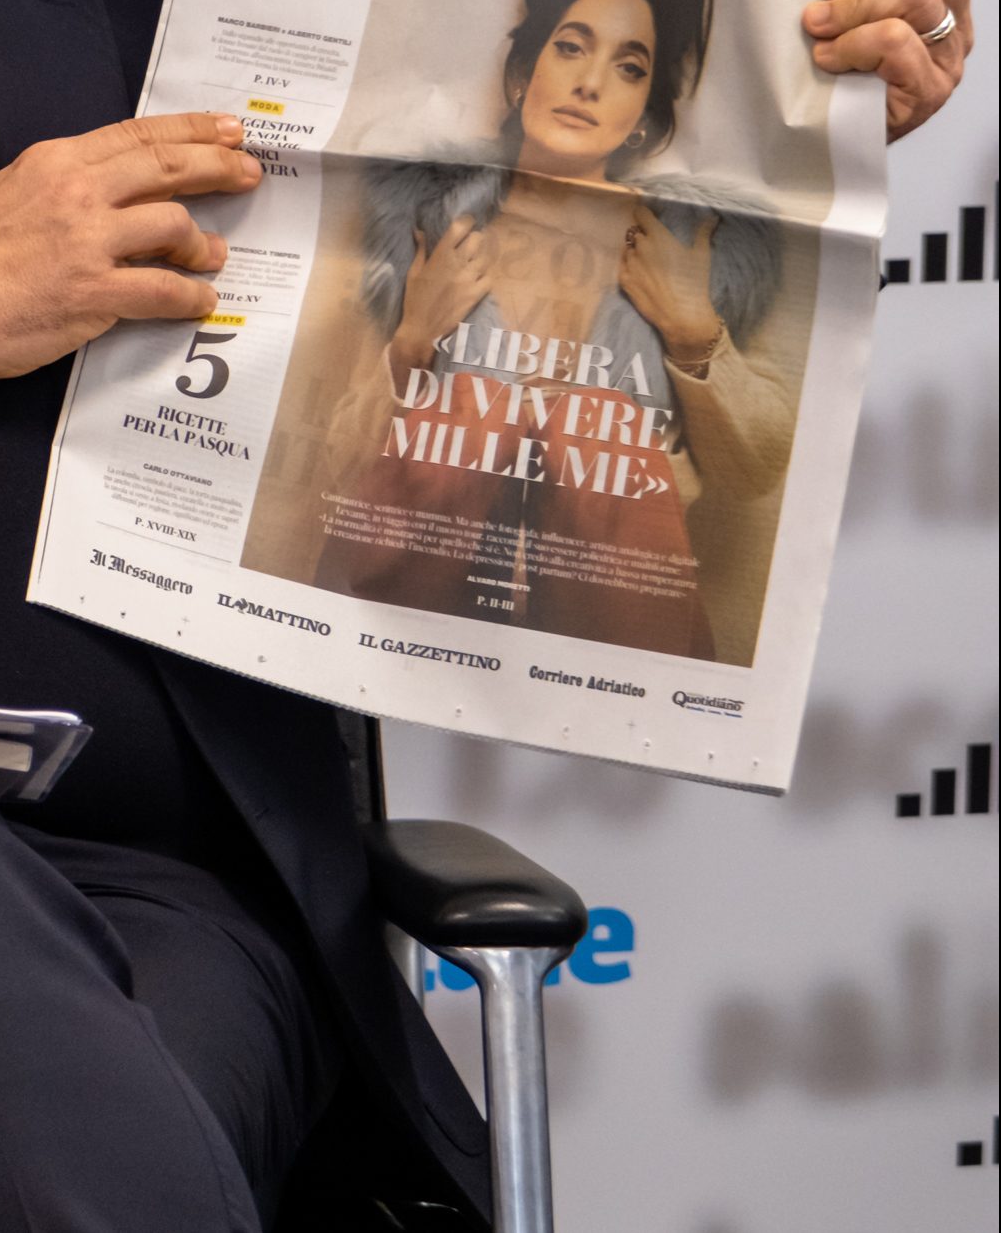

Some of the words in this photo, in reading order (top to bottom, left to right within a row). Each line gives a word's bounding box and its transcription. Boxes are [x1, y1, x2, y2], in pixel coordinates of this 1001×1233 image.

[217, 16, 244, 26] MARCO
[245, 21, 280, 33] BARBIERI
[287, 29, 321, 40] ALBERTO
[254, 74, 263, 85] P.
[265, 76, 291, 88] IV-V
[250, 100, 280, 112] MODA
[241, 117, 315, 134] GGESTIONI
[245, 294, 262, 303] XV
[175, 330, 238, 399] 5
[432, 322, 653, 397] «LIBERA
[157, 405, 228, 436] RICETTE
[402, 367, 455, 414] DI
[470, 376, 674, 451] VIVERE
[123, 414, 157, 435] PER
[158, 423, 180, 442] LA
[183, 430, 252, 461] PASQUA
[380, 415, 549, 483] MILLE
[555, 444, 670, 501] ME»
[142, 462, 169, 475] CARLO
[169, 470, 212, 487] OTTAVIANO
[135, 516, 144, 526] P.
[147, 521, 197, 542] XVIII-XIX
[89, 548, 107, 567] Il
[107, 554, 194, 595] Messaggero
[217, 592, 236, 609] IL
[246, 600, 331, 637] MATTINO
[476, 595, 487, 607] P.
[358, 632, 379, 649] IL
[380, 637, 501, 672] GAZZETTINO
[529, 665, 583, 688] Corriere
[586, 674, 646, 699] Adriatico
[672, 690, 745, 712] Quotidiano
